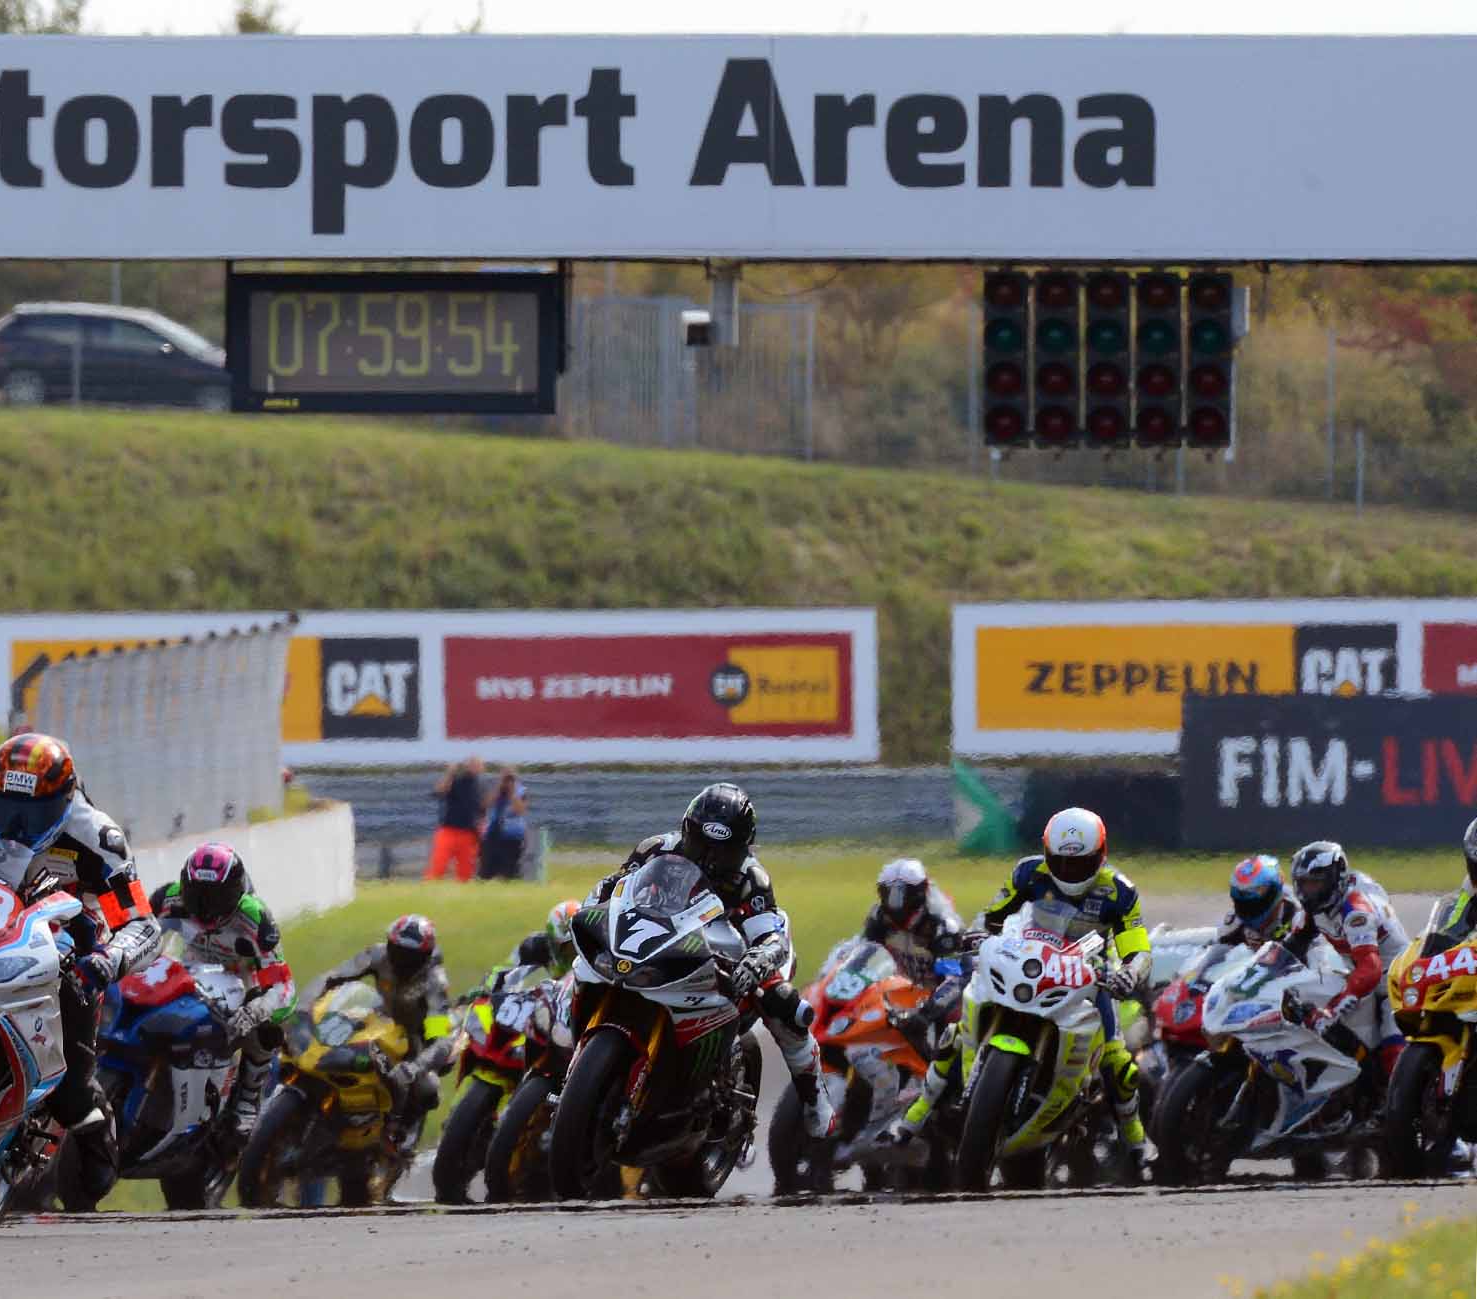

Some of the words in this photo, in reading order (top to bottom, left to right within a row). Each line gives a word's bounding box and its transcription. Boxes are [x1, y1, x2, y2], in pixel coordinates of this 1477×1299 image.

[689, 59, 1157, 189] Arena
[267, 293, 520, 377] 07:59:54
[326, 661, 413, 717] CAT
[543, 673, 673, 698] ZEPPELIN
[1025, 660, 1259, 696] ZEPPELIN
[1300, 646, 1393, 697] CAT
[5, 771, 36, 786] BMW
[619, 918, 671, 953] 7
